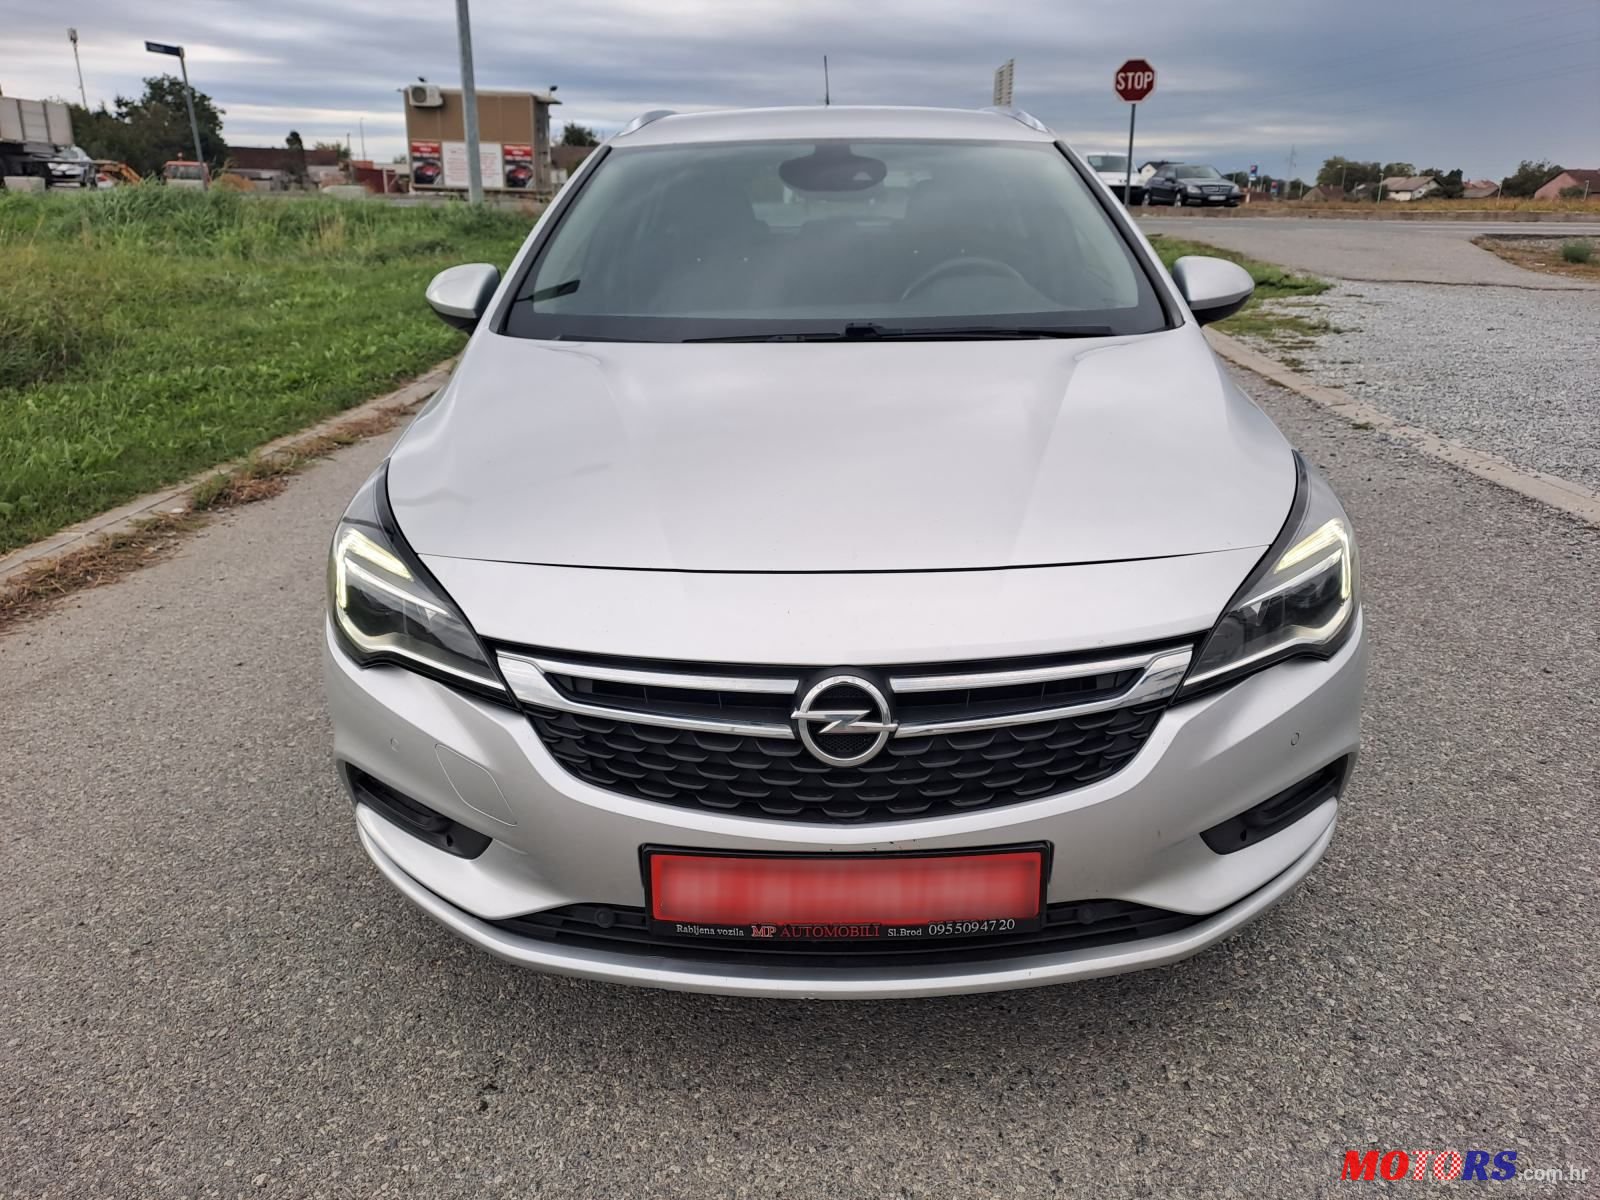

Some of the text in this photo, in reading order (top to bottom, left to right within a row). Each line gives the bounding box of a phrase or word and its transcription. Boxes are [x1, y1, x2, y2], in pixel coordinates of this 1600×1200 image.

[1116, 71, 1153, 90] STOP
[676, 924, 715, 935] Rabljena
[717, 928, 744, 937] vozila
[751, 925, 776, 938] MP
[780, 926, 880, 938] AUTOMOBILI
